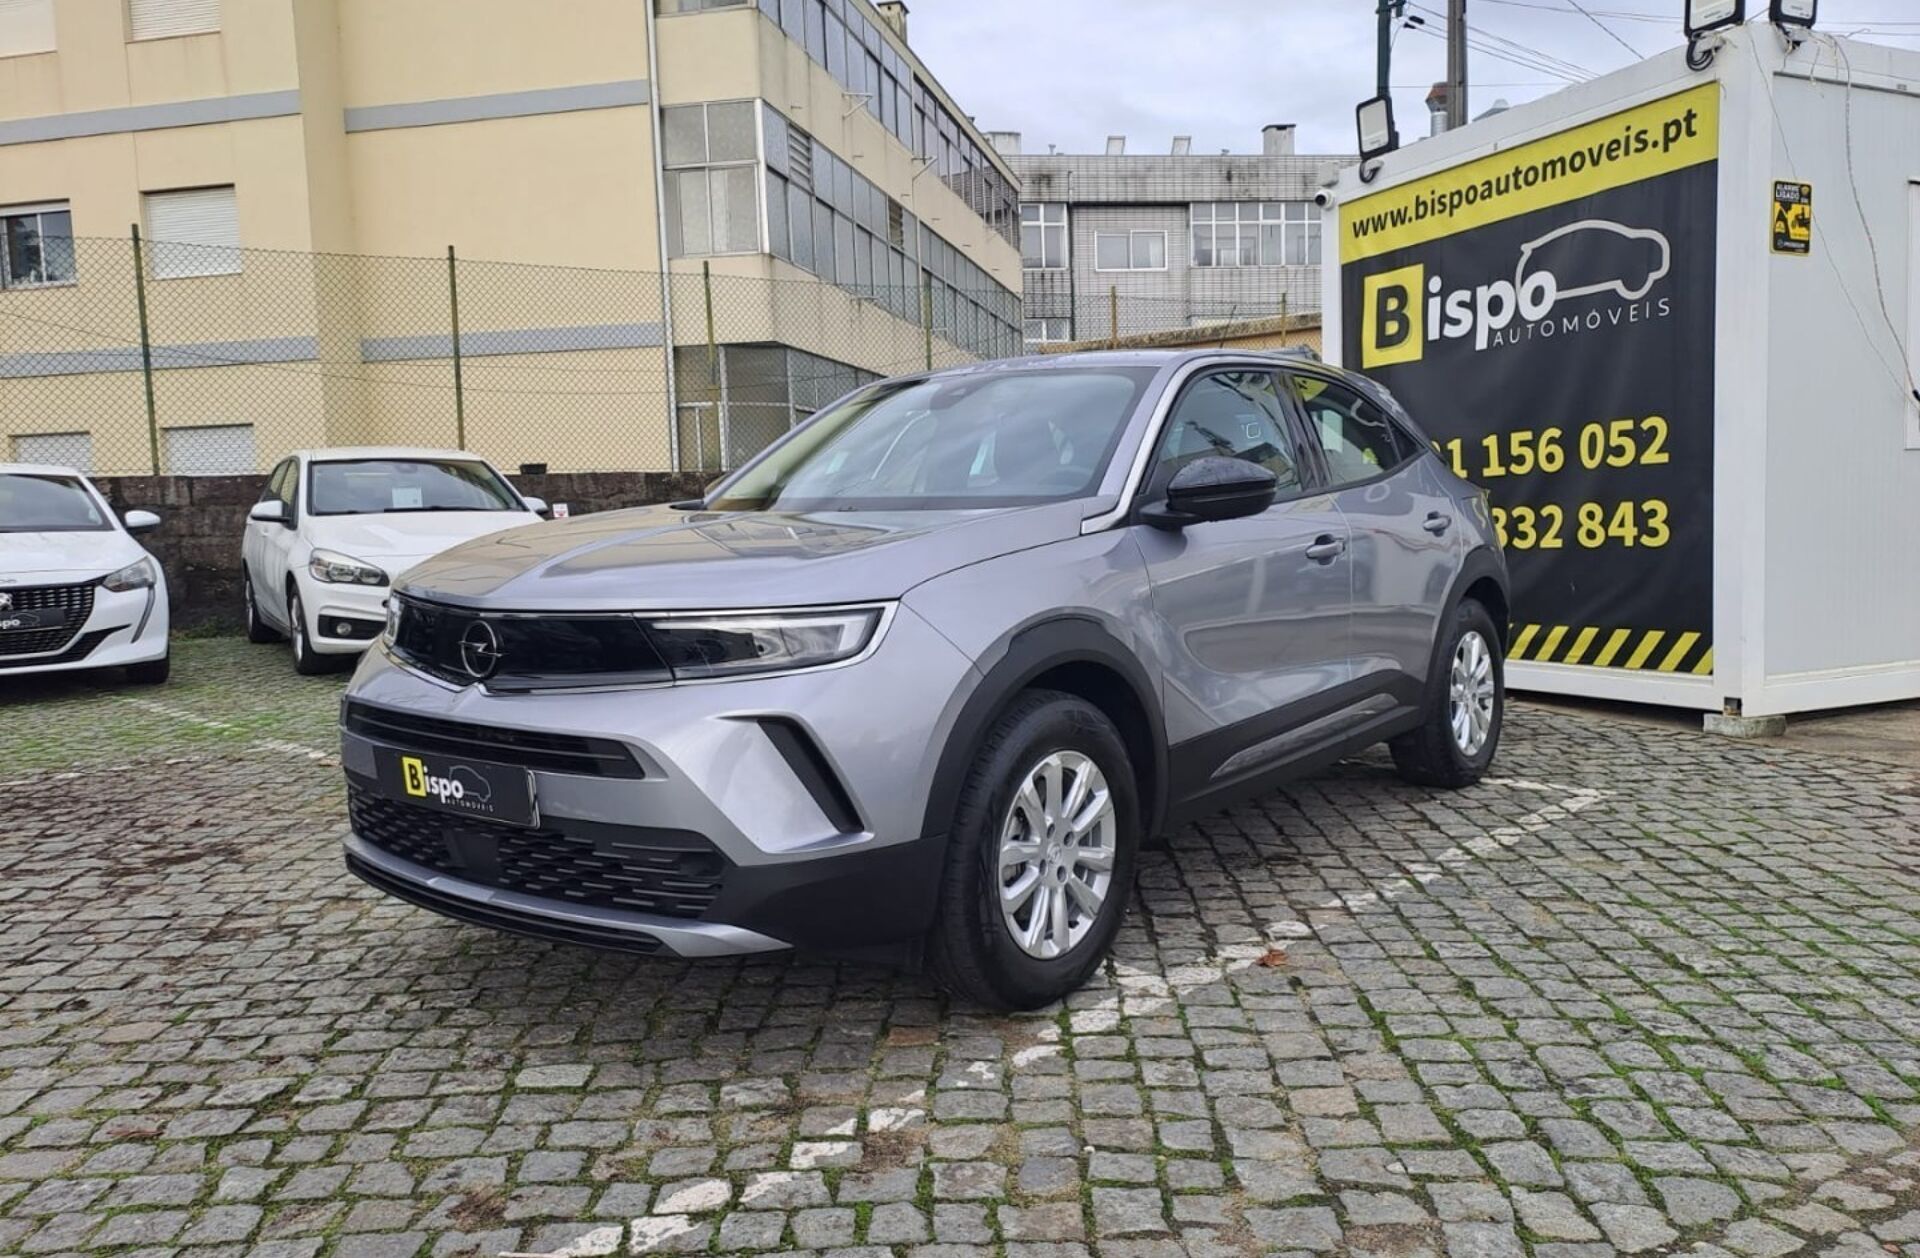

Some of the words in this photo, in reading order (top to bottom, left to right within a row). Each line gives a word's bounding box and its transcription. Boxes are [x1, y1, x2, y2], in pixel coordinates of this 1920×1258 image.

[1352, 109, 1698, 239] www.bispoautomoveis.pt
[1375, 270, 1557, 351] Bispo
[1493, 297, 1671, 348] AUTOMÓVEIS
[1482, 427, 1565, 478] 156
[1579, 416, 1670, 470] 052
[1577, 499, 1671, 548] 843
[408, 763, 465, 804] Bispo
